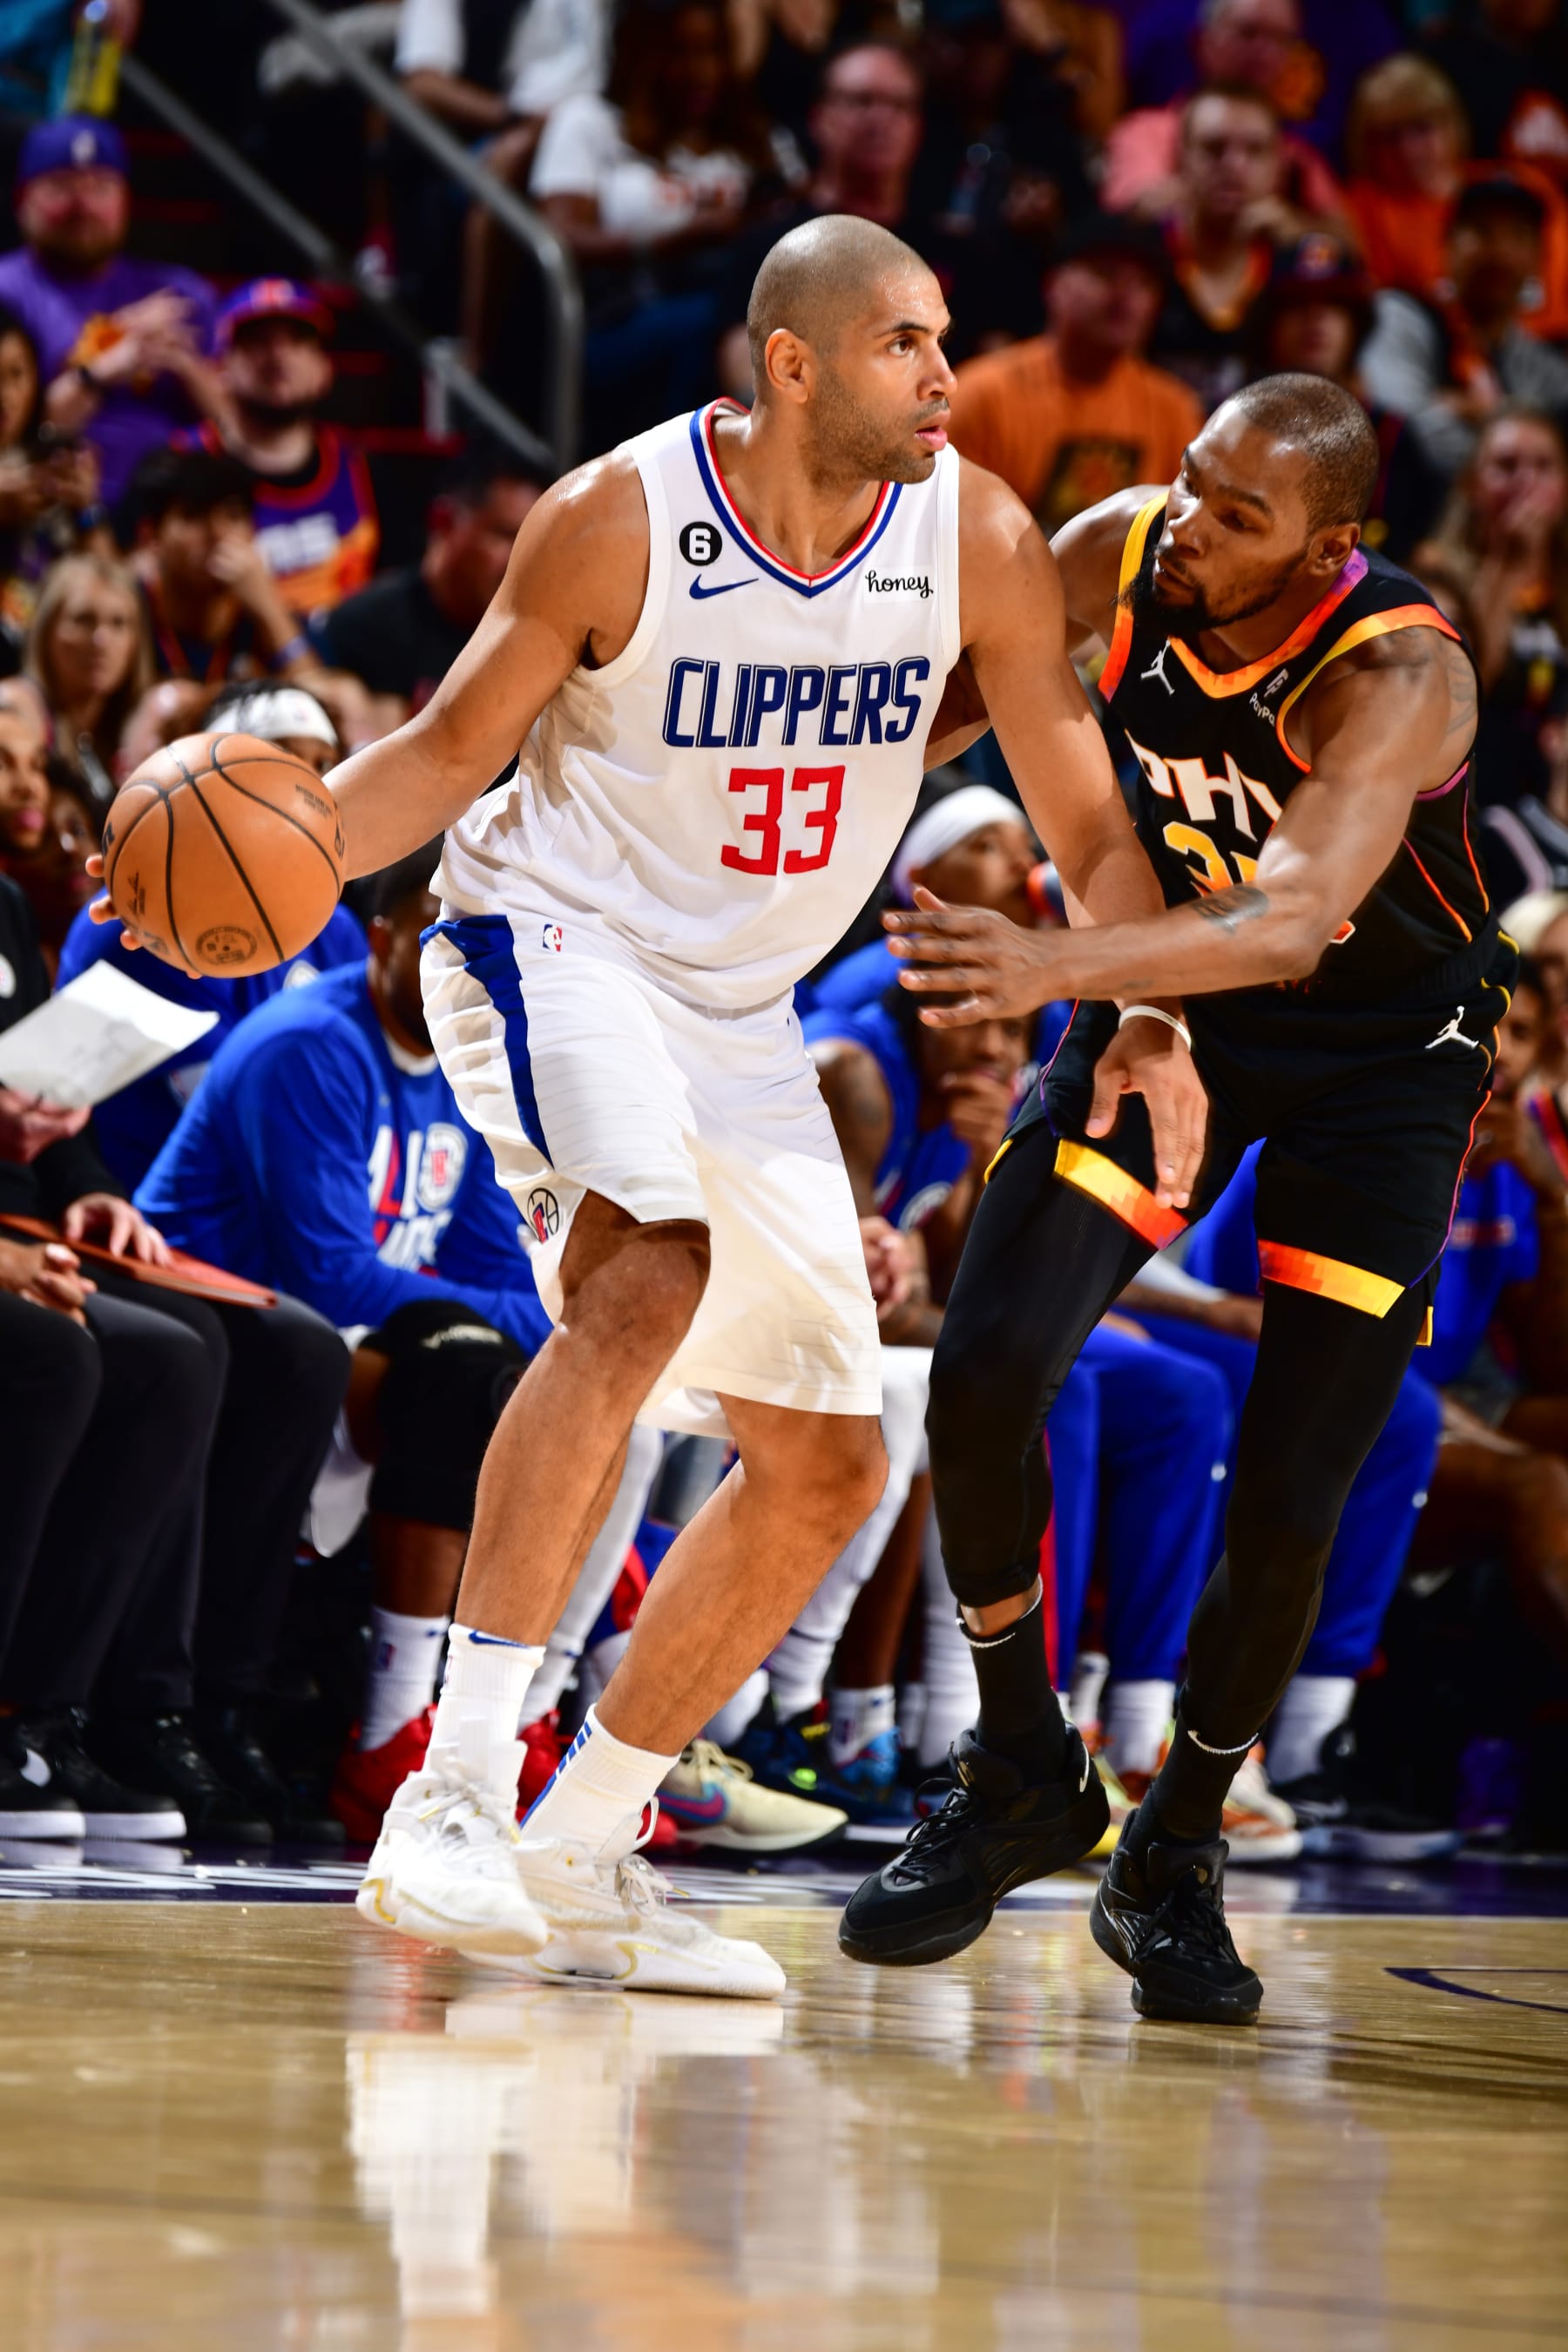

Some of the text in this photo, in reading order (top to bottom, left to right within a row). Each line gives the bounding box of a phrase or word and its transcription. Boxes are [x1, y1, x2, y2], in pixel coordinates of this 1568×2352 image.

[689, 528, 711, 561] 6
[865, 570, 934, 599] honey
[662, 656, 930, 748] CLIPPERS
[1249, 692, 1275, 727] PayPa
[720, 765, 846, 876] 33
